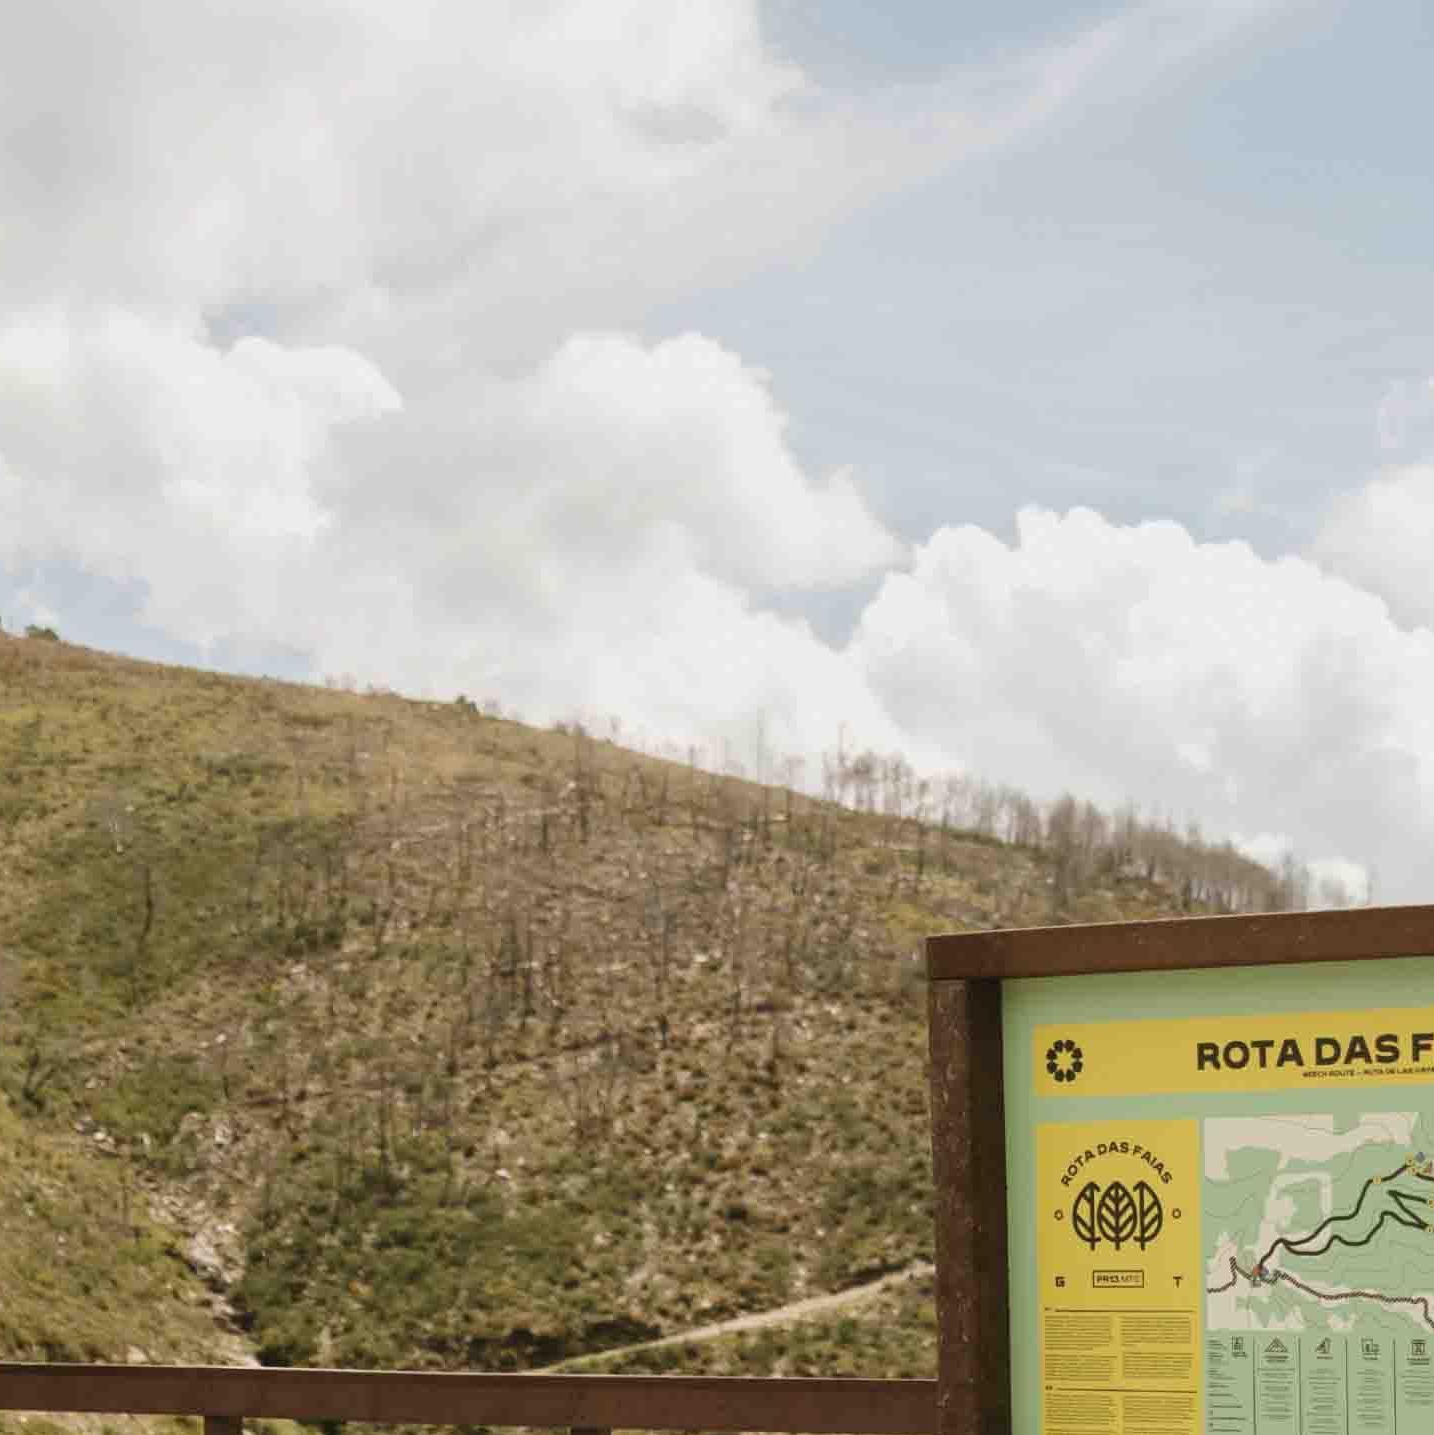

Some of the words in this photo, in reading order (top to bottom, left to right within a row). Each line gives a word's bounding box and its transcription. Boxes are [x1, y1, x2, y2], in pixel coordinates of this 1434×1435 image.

[1196, 1039, 1304, 1071] ROTA
[1316, 1033, 1401, 1067] DAS
[1061, 1149, 1096, 1187] ROTA
[1097, 1141, 1130, 1156] DAS
[1132, 1145, 1173, 1185] FAIAS
[1055, 1276, 1066, 1287] G
[1173, 1276, 1183, 1288] T
